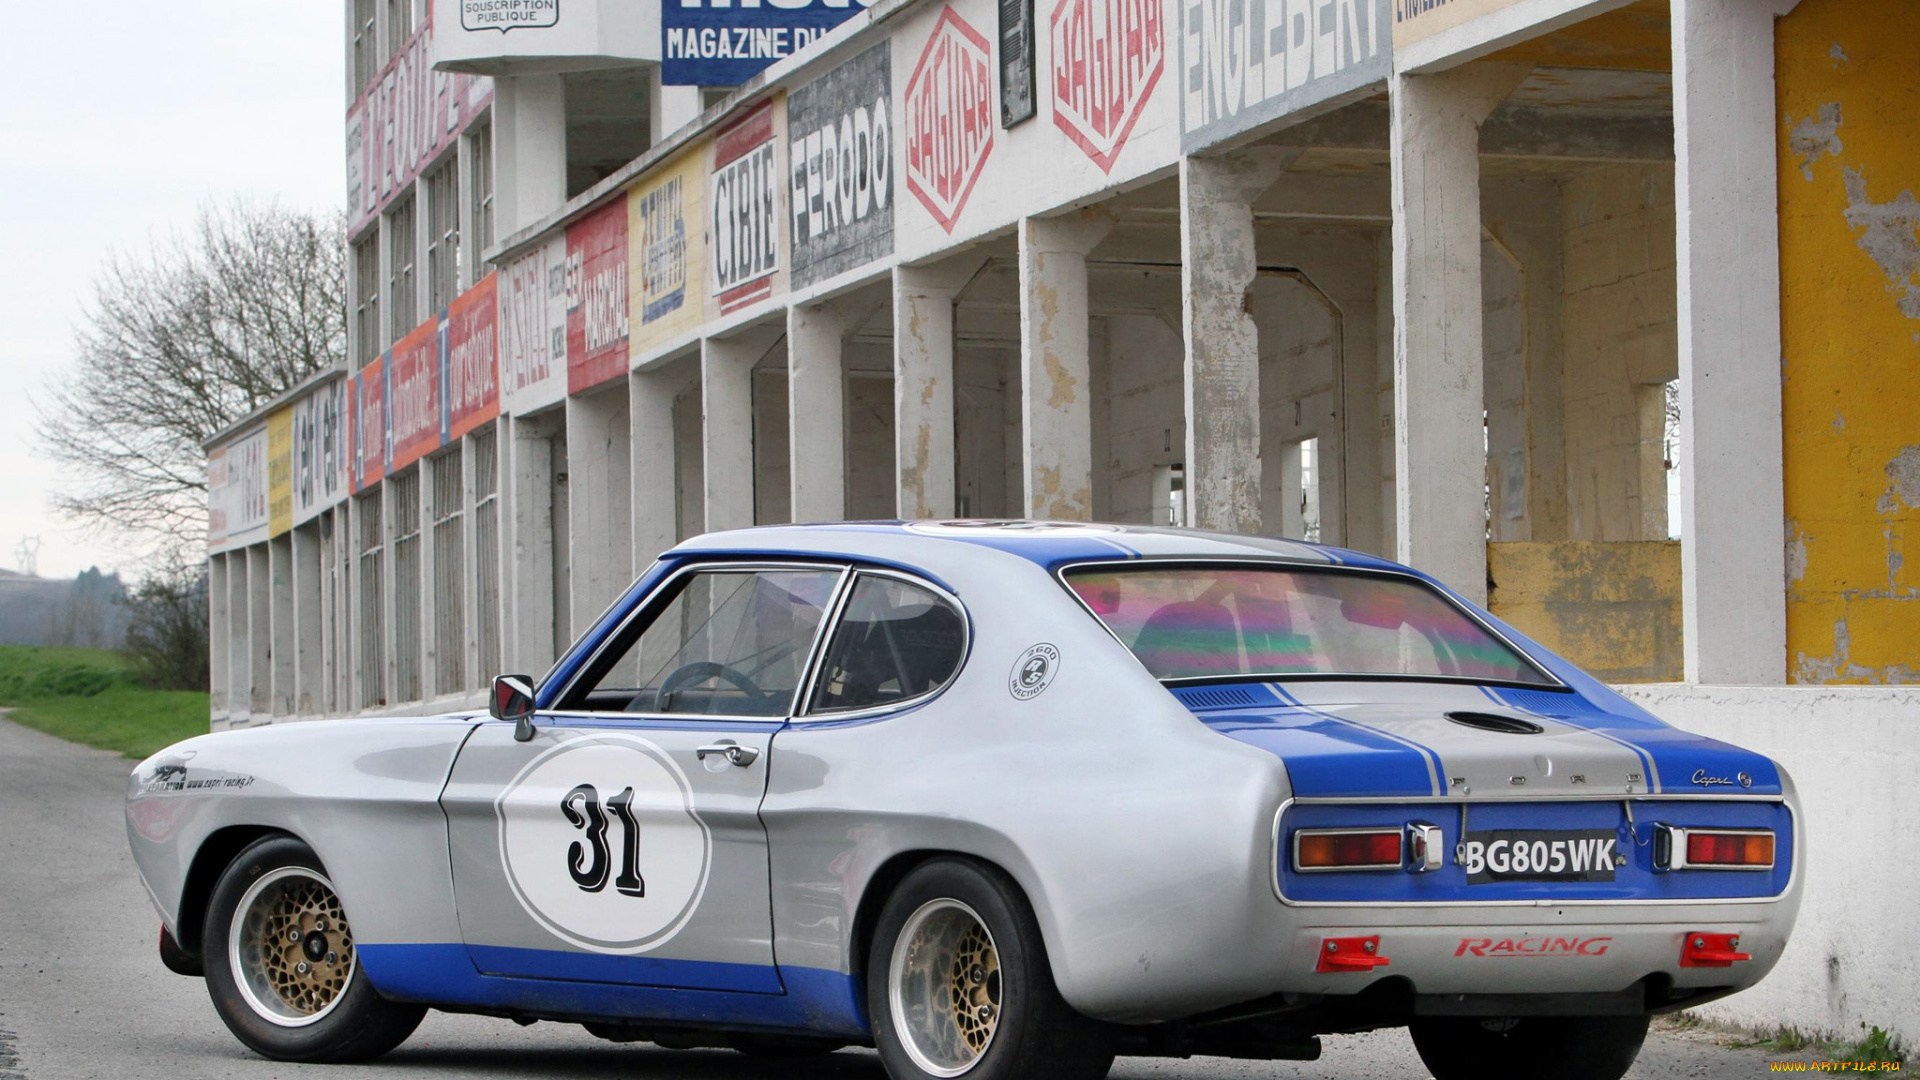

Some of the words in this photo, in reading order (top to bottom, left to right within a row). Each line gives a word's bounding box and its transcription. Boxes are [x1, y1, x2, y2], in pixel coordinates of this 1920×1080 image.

[465, 0, 553, 13] SOUSCRIPTION
[477, 11, 537, 22] PUBLIQUE
[667, 28, 789, 59] MAGAZINE
[1056, 0, 1159, 140] JAGUAR
[909, 32, 989, 205] JAGUAR
[791, 97, 889, 244] FERODO
[1027, 646, 1057, 661] 2600
[1011, 679, 1046, 697] INJECTION
[187, 775, 254, 789] www.capri-racing.fr
[1449, 773, 1642, 787] FORD
[1691, 769, 1734, 787] Capri
[560, 783, 646, 898] 31
[1466, 838, 1617, 874] BG805WK
[1454, 937, 1612, 958] RACING
